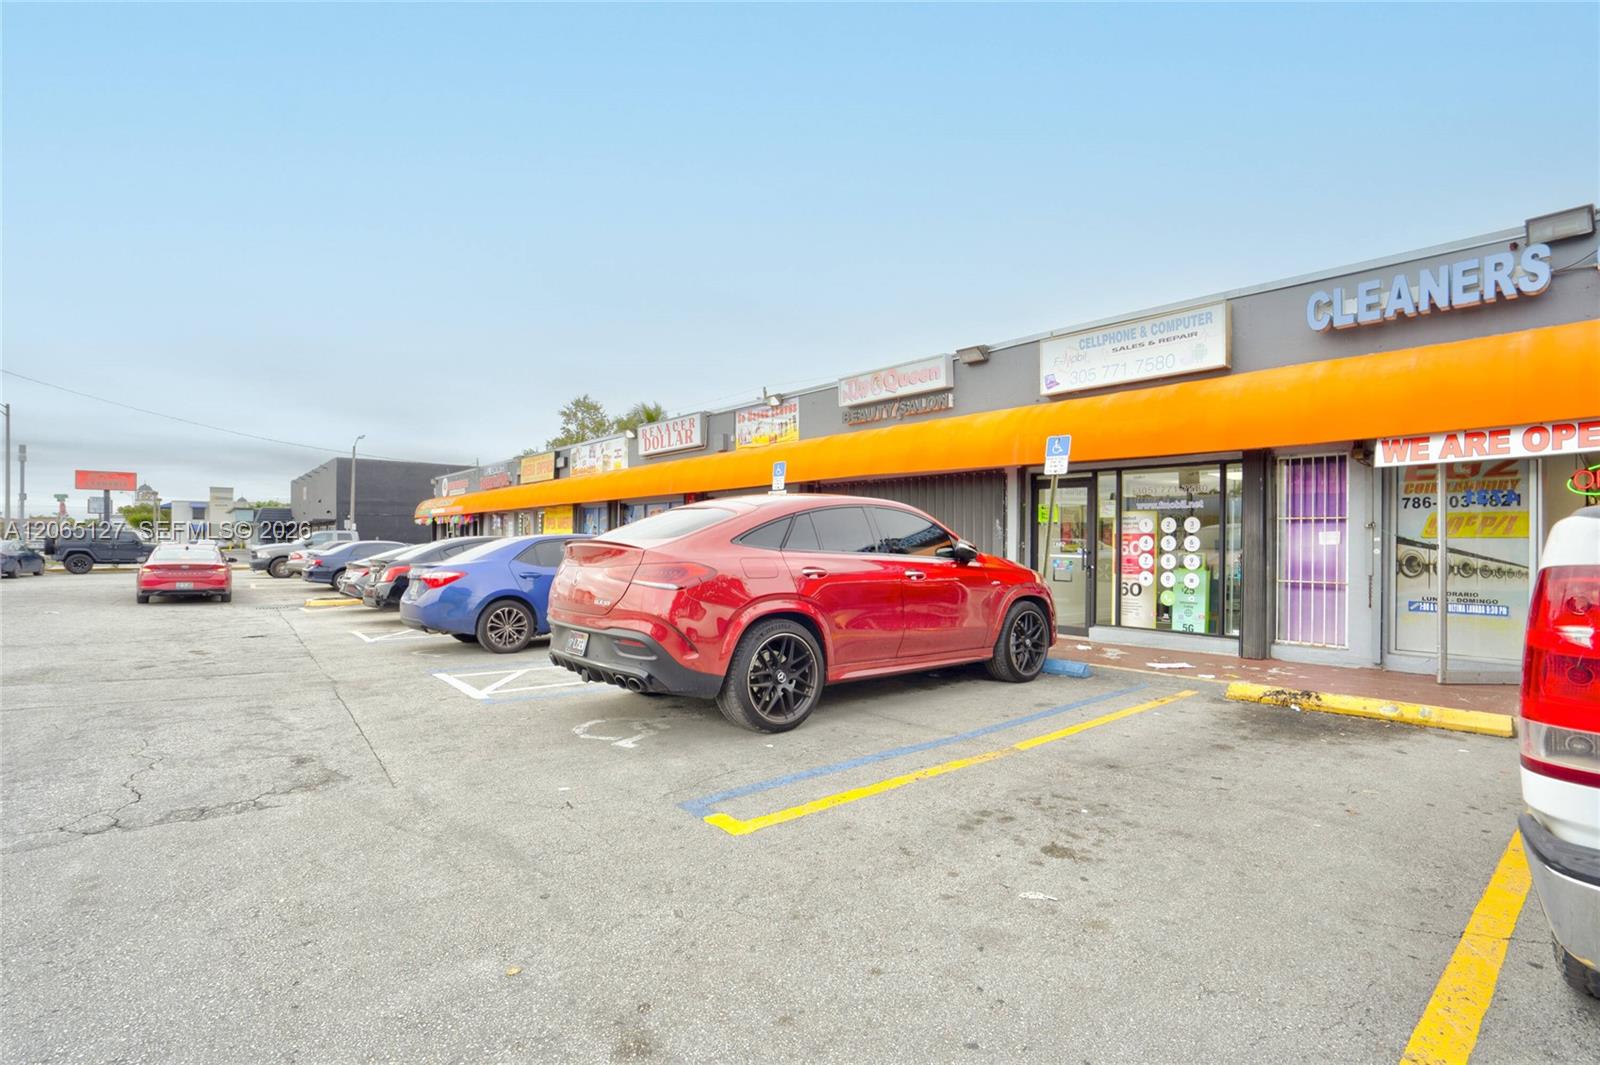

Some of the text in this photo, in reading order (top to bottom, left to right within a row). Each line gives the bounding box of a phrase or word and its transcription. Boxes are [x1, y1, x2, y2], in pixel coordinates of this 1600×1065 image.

[1306, 243, 1552, 333] CLEANERS
[1078, 311, 1214, 351] CELLPHONE & COMPUTER
[1111, 341, 1145, 353] SALES
[1158, 331, 1198, 345] REPAIR
[883, 367, 941, 393] Queen
[1070, 353, 1176, 386] 305 771 7580
[842, 393, 954, 426] BEAUTY SALON
[643, 430, 694, 451] DOLLAR
[1381, 436, 1431, 463] WE
[1438, 428, 1512, 459] ARE
